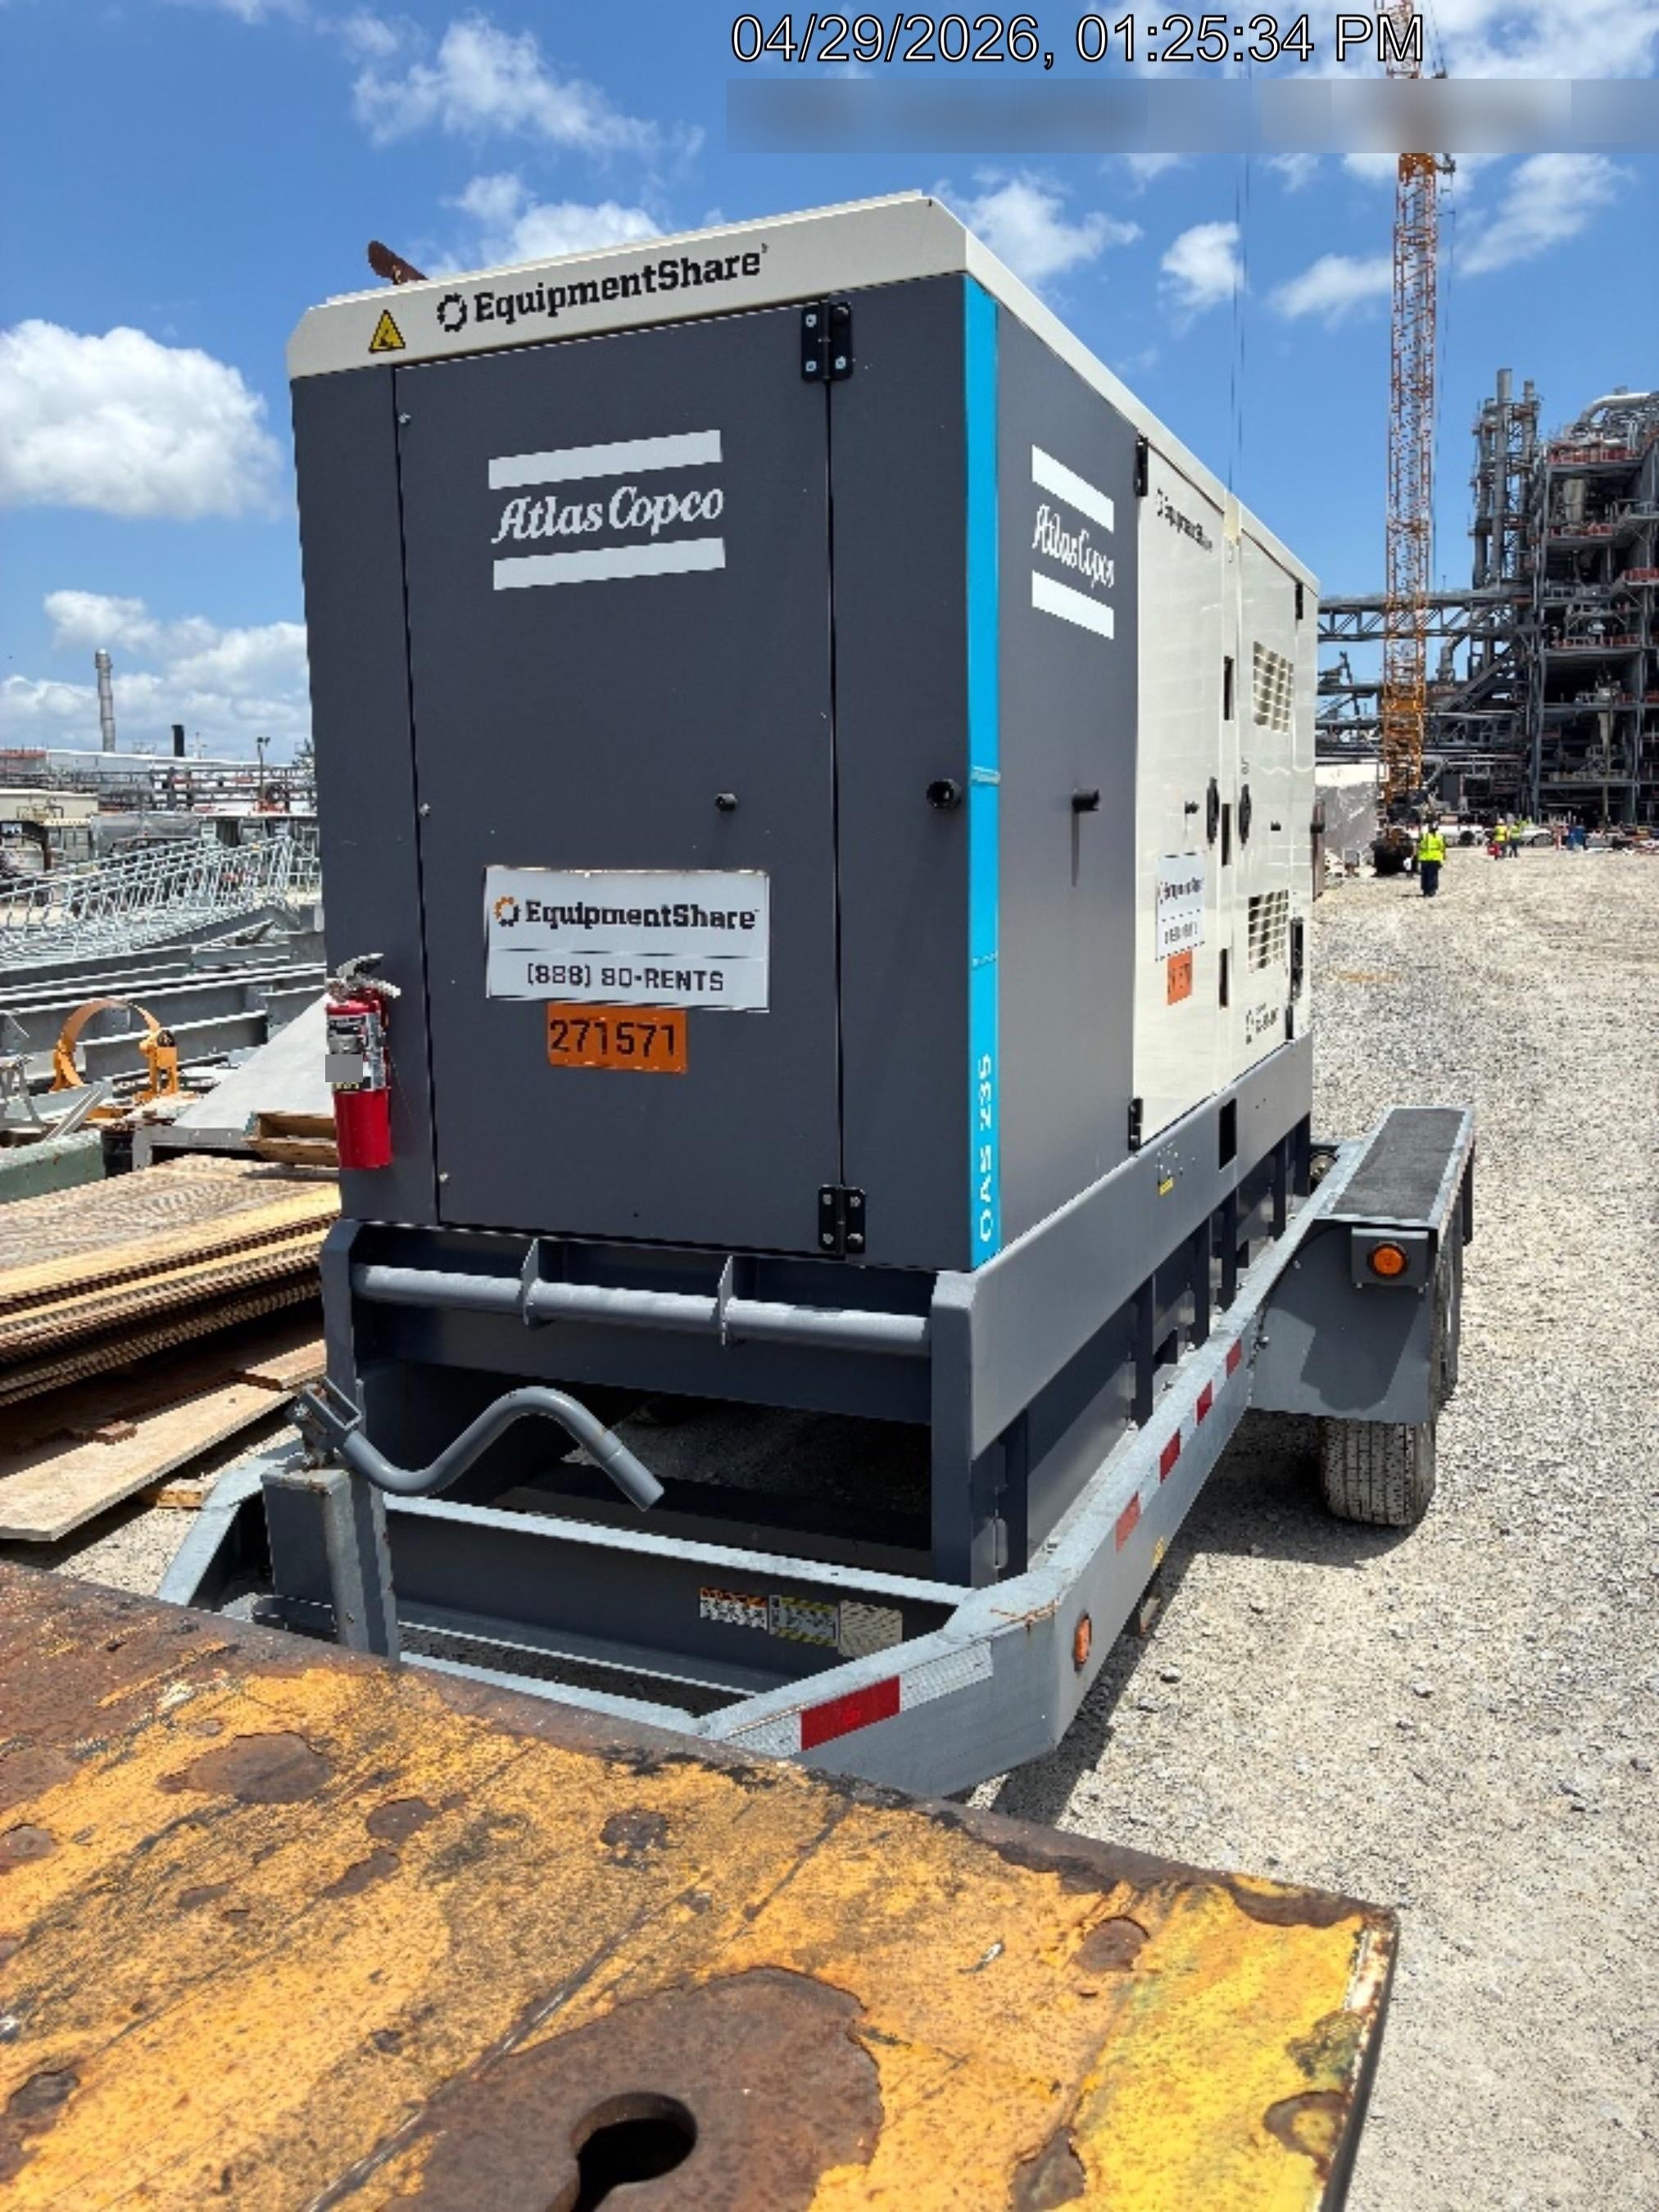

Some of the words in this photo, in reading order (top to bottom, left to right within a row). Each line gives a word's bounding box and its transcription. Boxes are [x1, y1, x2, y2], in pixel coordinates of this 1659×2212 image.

[474, 252, 761, 325] EquipmentShare
[491, 496, 603, 544] Atlas
[609, 486, 724, 537] Copco
[525, 900, 756, 929] EquipmentShare
[528, 963, 591, 988] (888)
[601, 967, 724, 991] 80-RENTS
[549, 1018, 676, 1058] 271571
